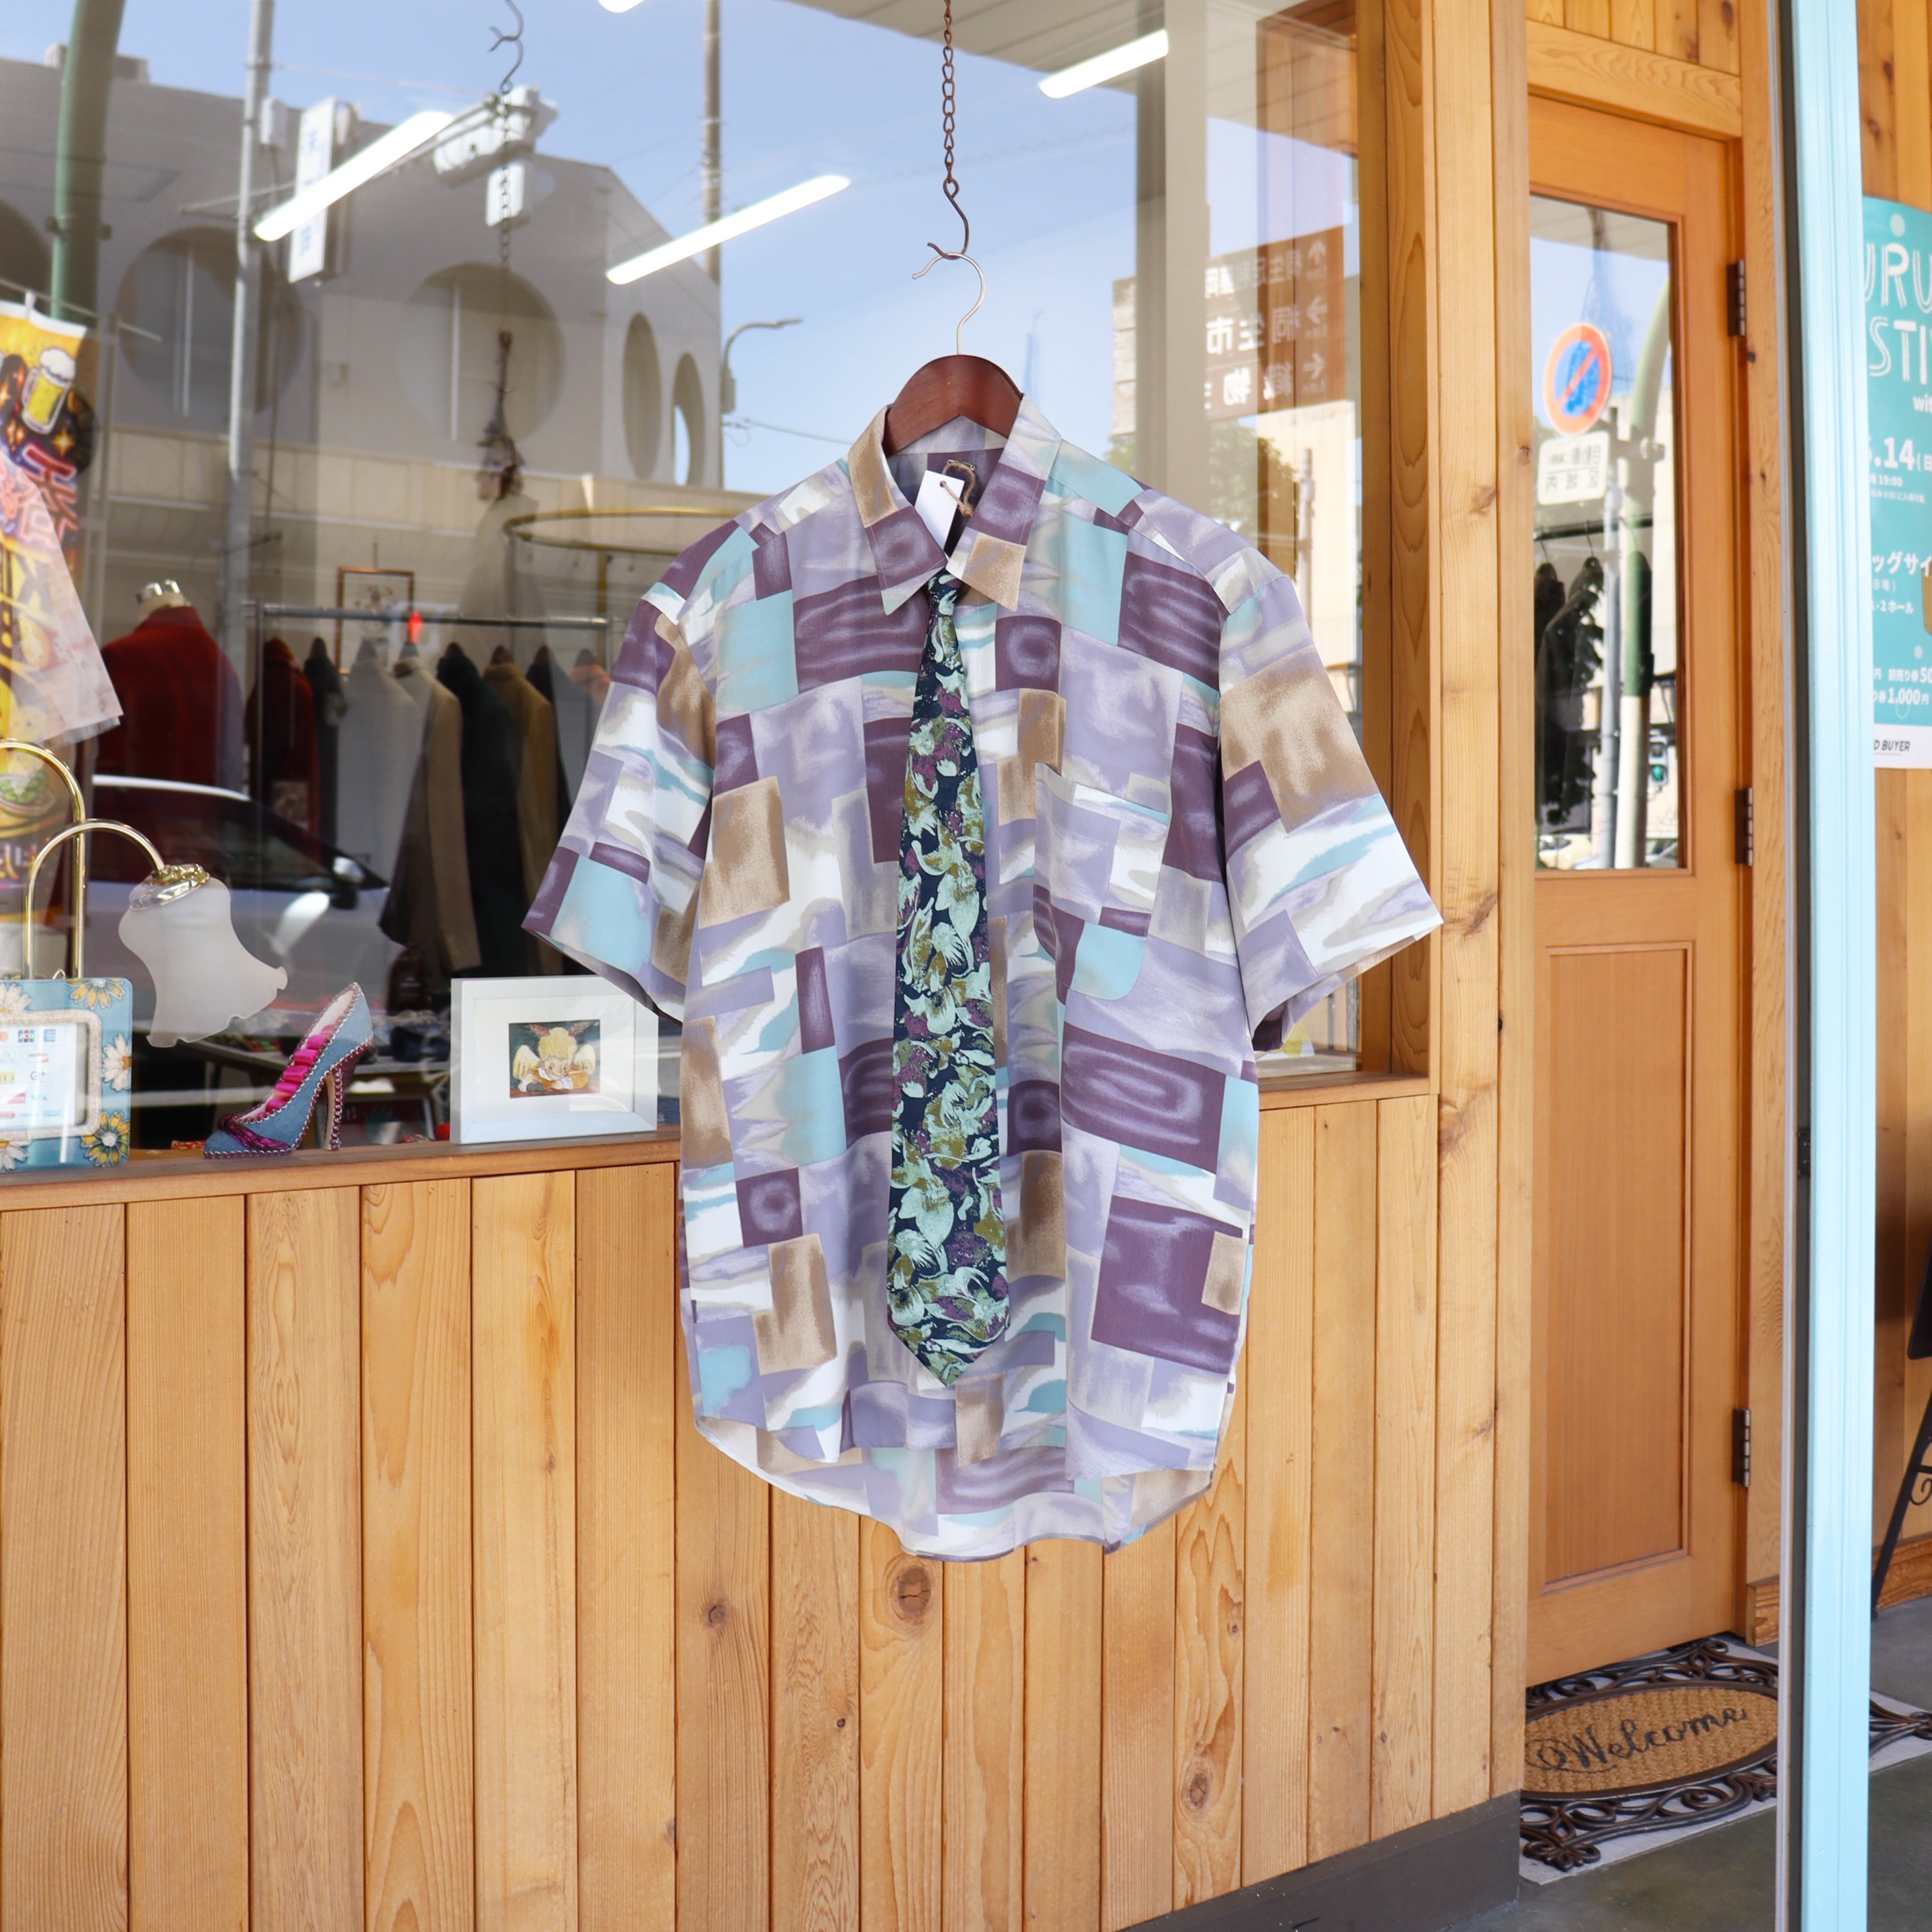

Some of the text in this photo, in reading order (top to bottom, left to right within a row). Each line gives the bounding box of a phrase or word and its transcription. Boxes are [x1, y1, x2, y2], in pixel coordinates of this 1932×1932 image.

[1869, 316, 1932, 384] STI
[1872, 551, 1932, 577] ッグサイ
[1882, 740, 1910, 752] BUYER
[1524, 1708, 1748, 1774] Welcome
